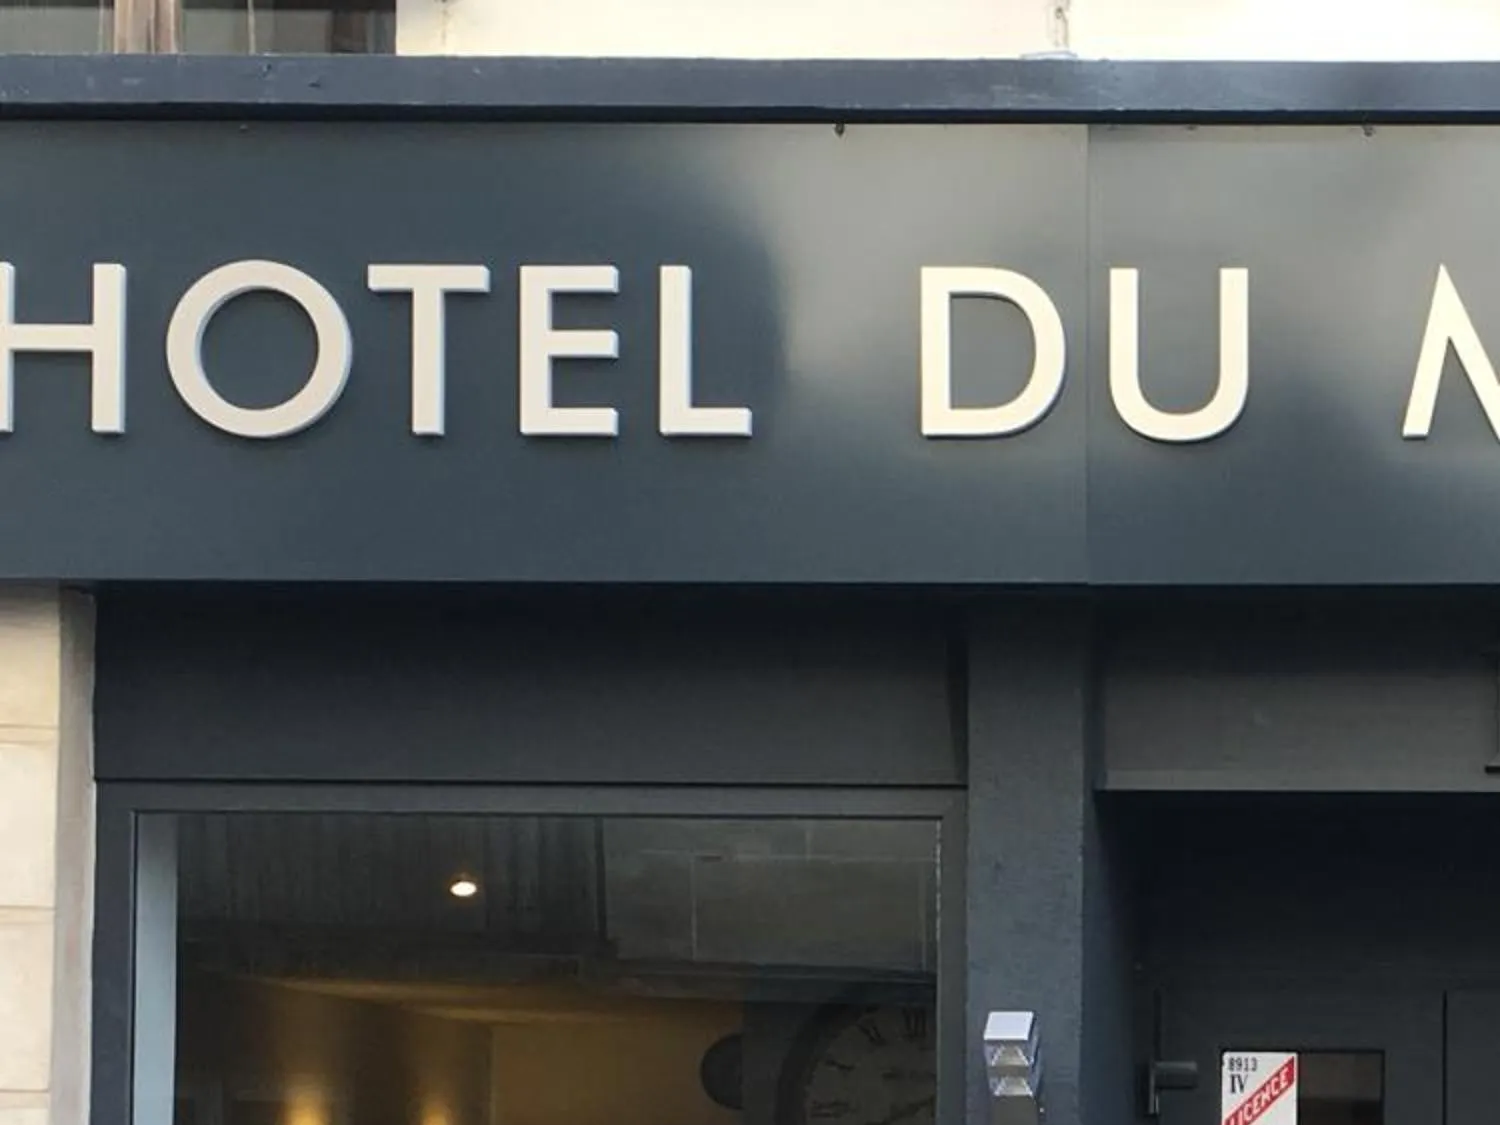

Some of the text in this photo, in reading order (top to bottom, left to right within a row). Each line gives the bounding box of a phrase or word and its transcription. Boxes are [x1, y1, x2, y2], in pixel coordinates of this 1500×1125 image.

[0, 259, 753, 438] HOTEL
[920, 266, 1250, 442] DU
[1230, 1073, 1249, 1094] IV
